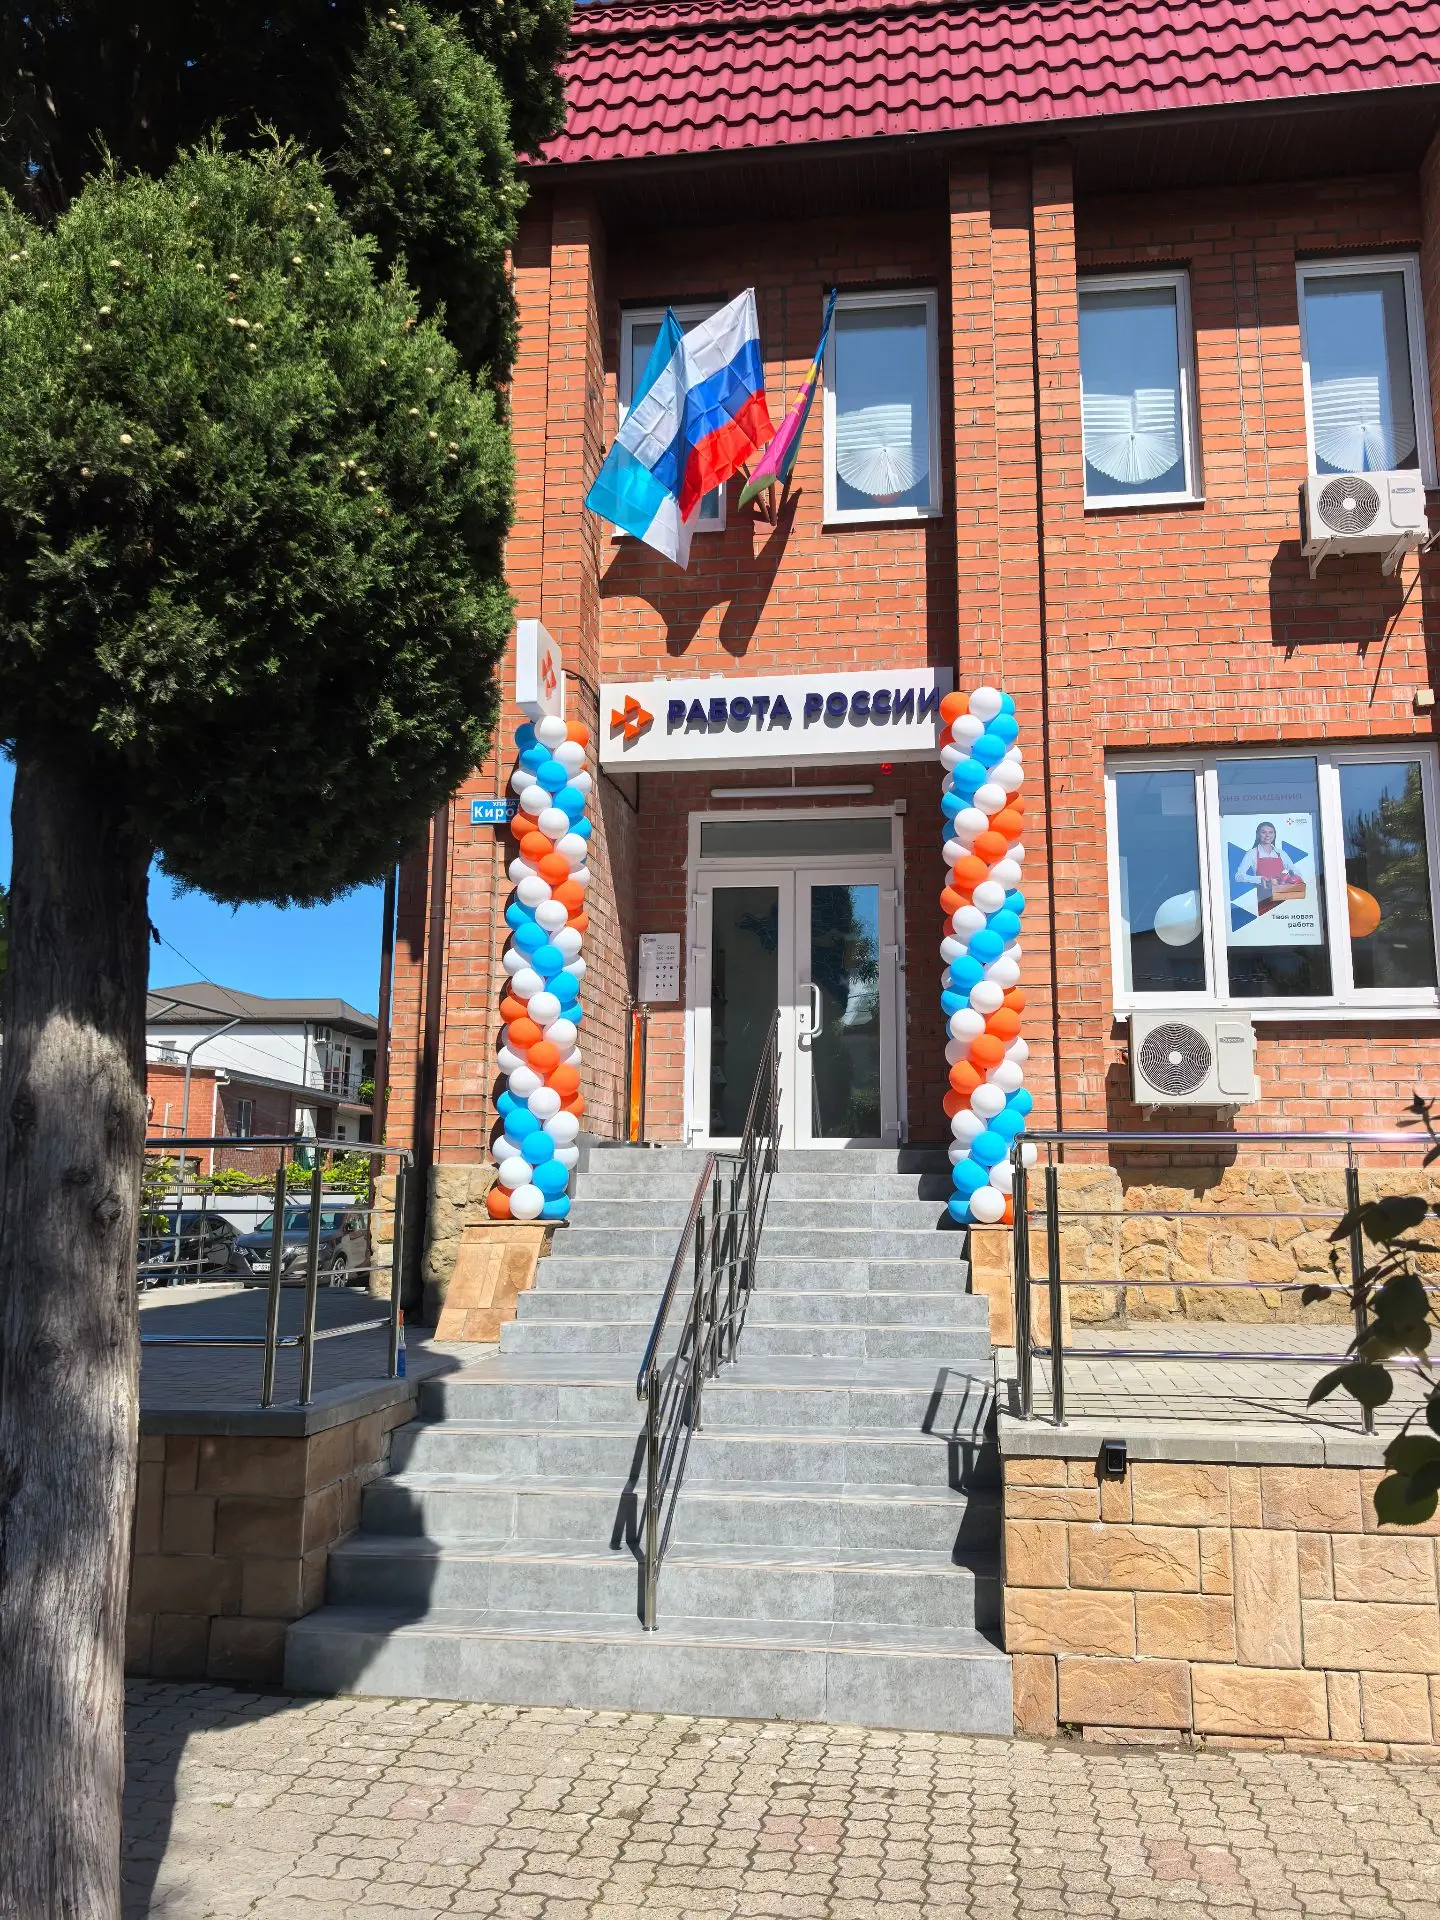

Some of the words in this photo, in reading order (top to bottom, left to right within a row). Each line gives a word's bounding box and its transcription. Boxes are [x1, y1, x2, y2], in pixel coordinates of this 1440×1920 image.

[668, 694, 792, 724] РАБОТА
[805, 686, 940, 718] РОССИИ
[474, 805, 515, 821] Киро
